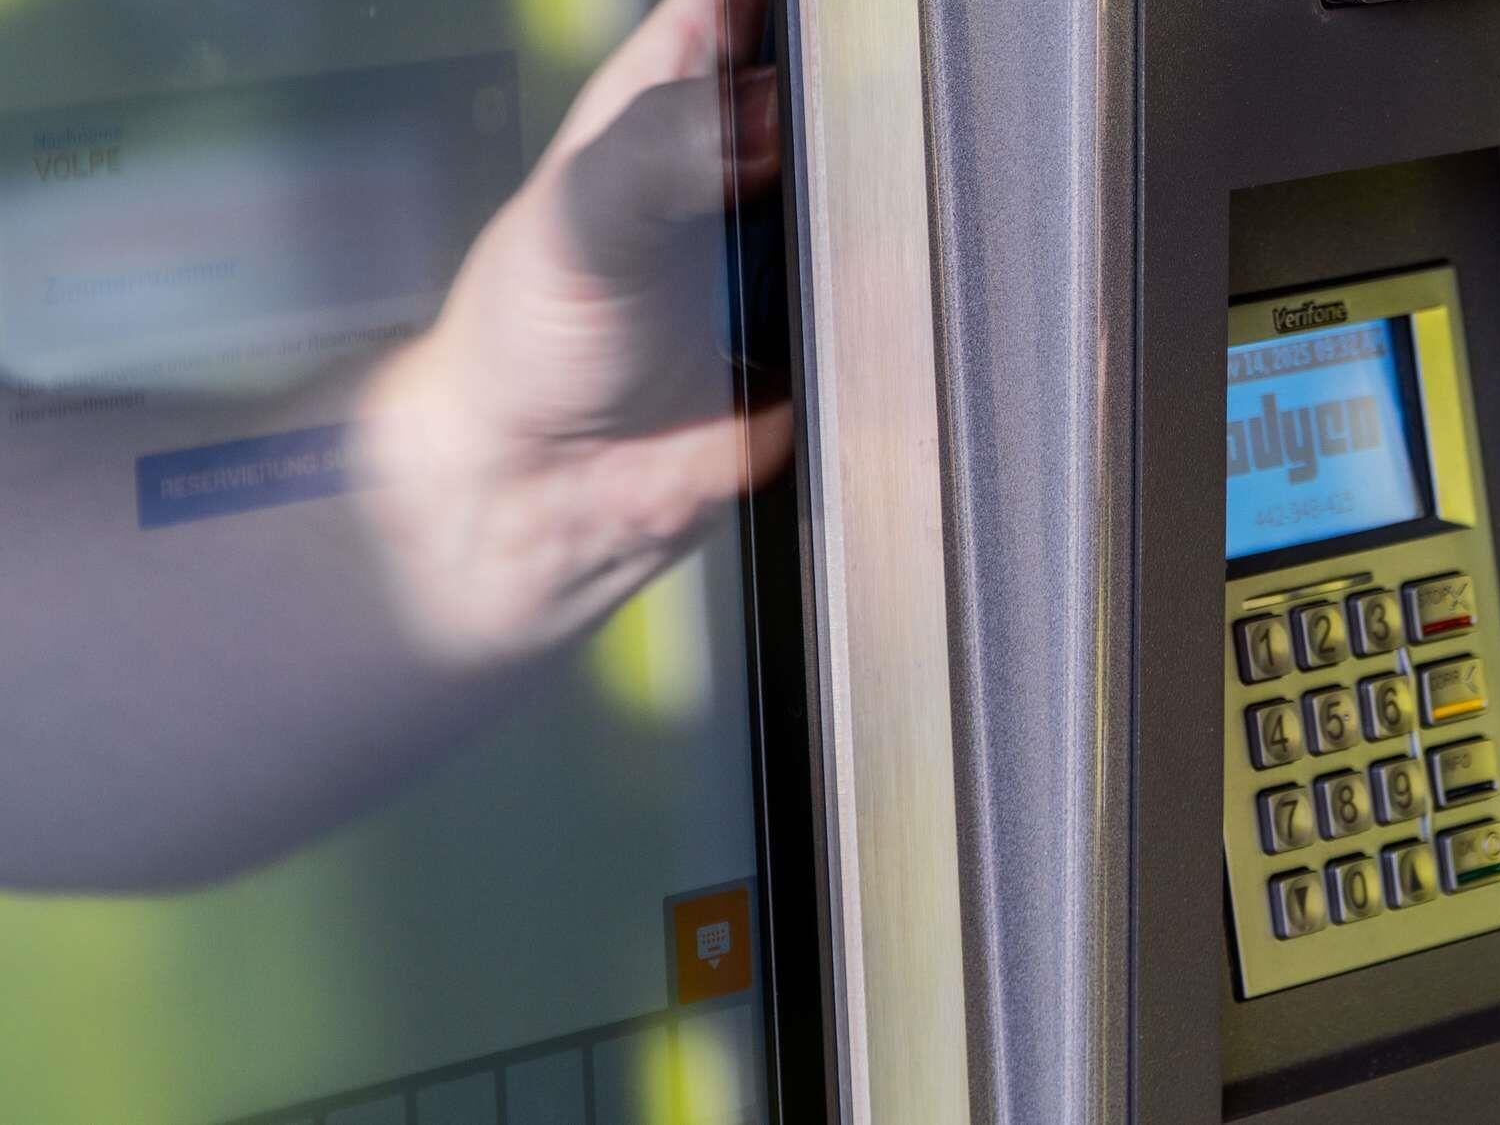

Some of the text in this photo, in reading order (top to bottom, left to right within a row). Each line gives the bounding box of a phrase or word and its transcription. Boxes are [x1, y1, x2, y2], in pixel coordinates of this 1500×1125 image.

[33, 145, 122, 182] VOLPE
[1273, 301, 1348, 332] Verifone
[1259, 631, 1275, 667] 1
[1317, 615, 1335, 653] 2
[1370, 602, 1390, 642] 3
[1269, 714, 1289, 753] 4
[1326, 700, 1345, 740] 5
[1383, 687, 1401, 726] 6
[1279, 799, 1298, 839] 7
[1338, 784, 1358, 825] 8
[1394, 770, 1412, 810] 9
[1351, 870, 1369, 911] 0
